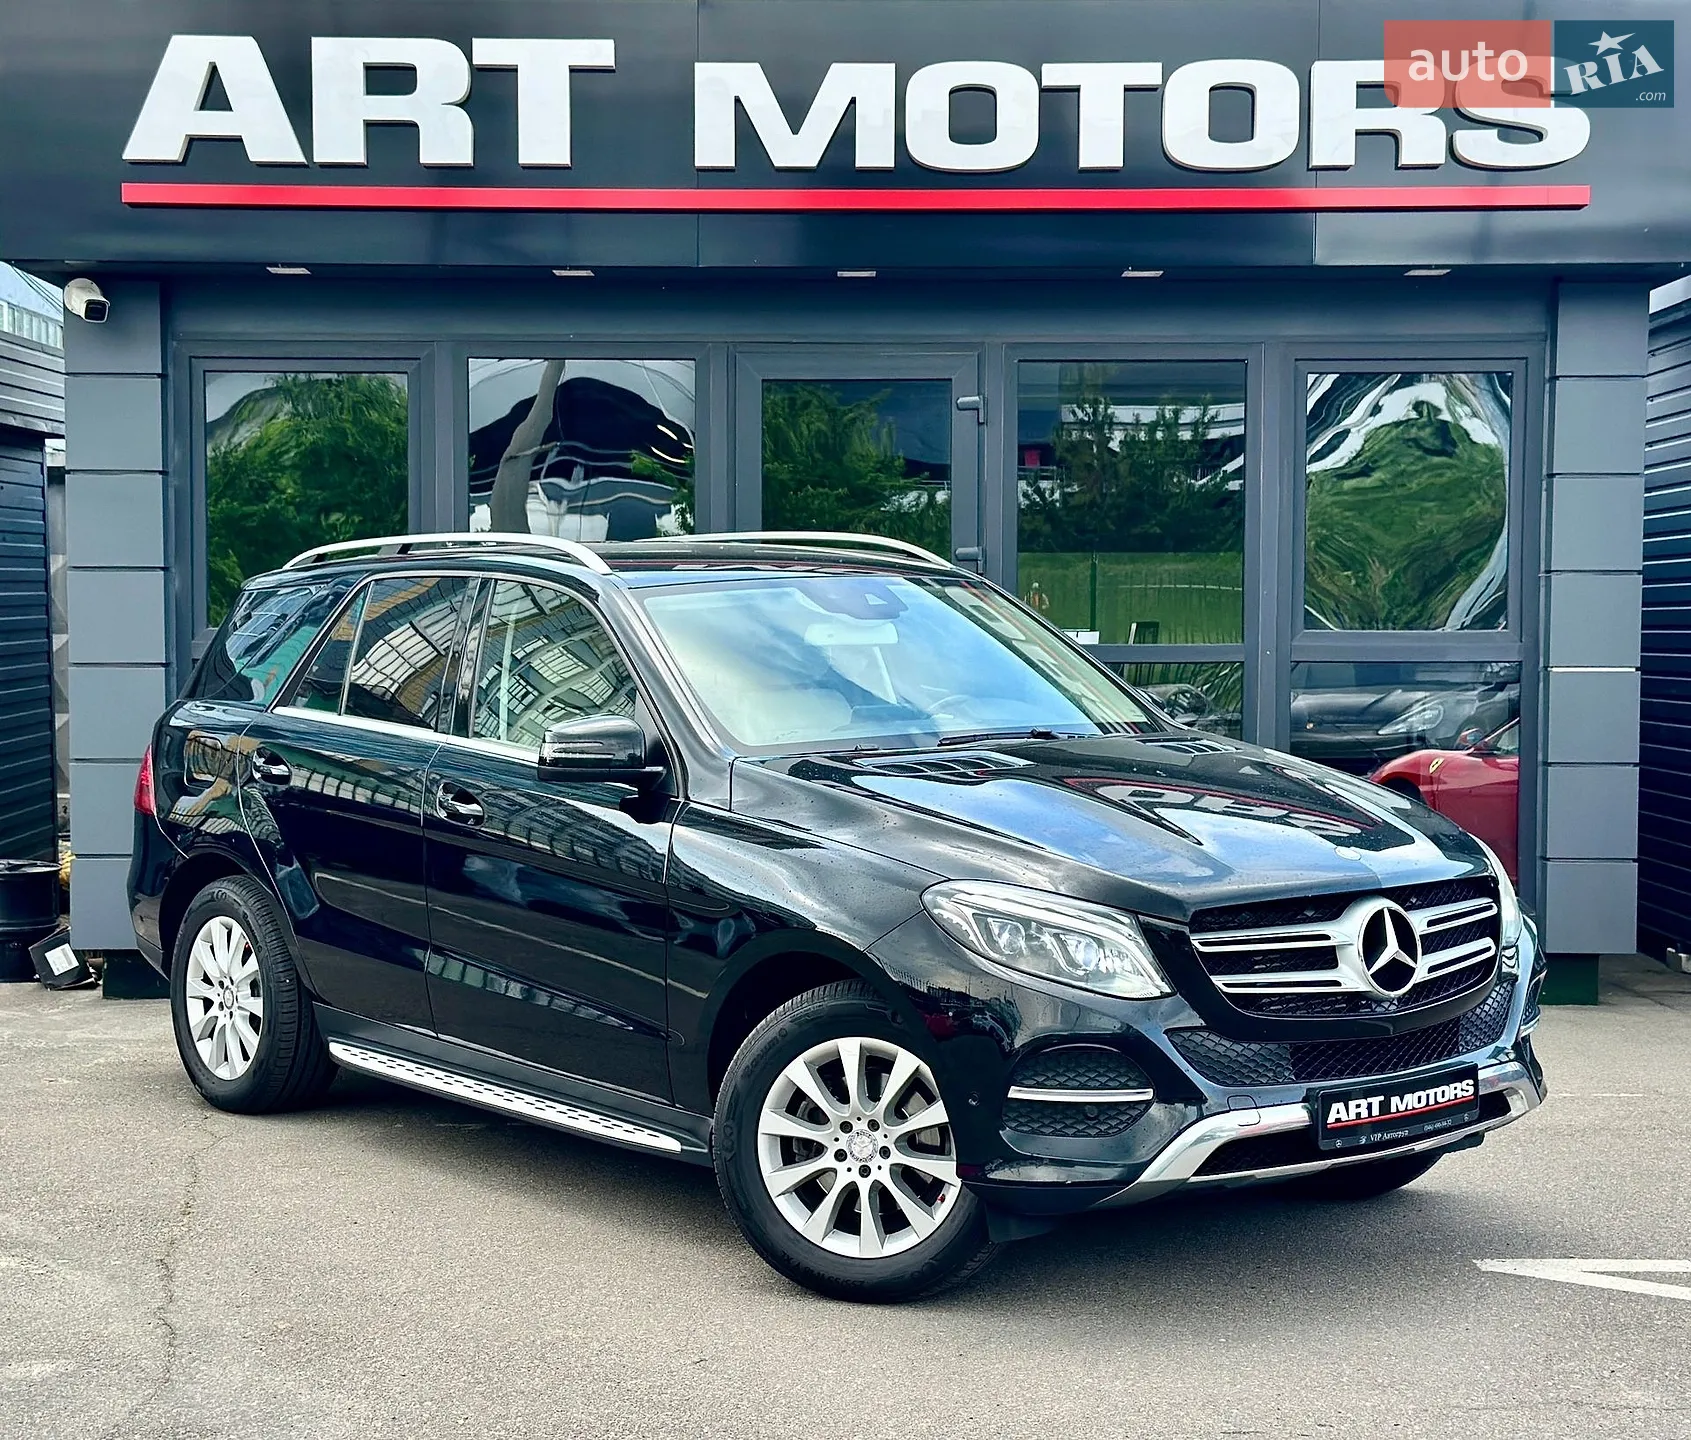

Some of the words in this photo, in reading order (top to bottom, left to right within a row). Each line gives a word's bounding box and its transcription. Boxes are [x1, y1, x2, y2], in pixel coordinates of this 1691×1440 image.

[121, 34, 616, 168] ART
[694, 57, 1591, 172] MOTORS
[1326, 1095, 1385, 1124] ART
[1390, 1079, 1475, 1113] MOTORS
